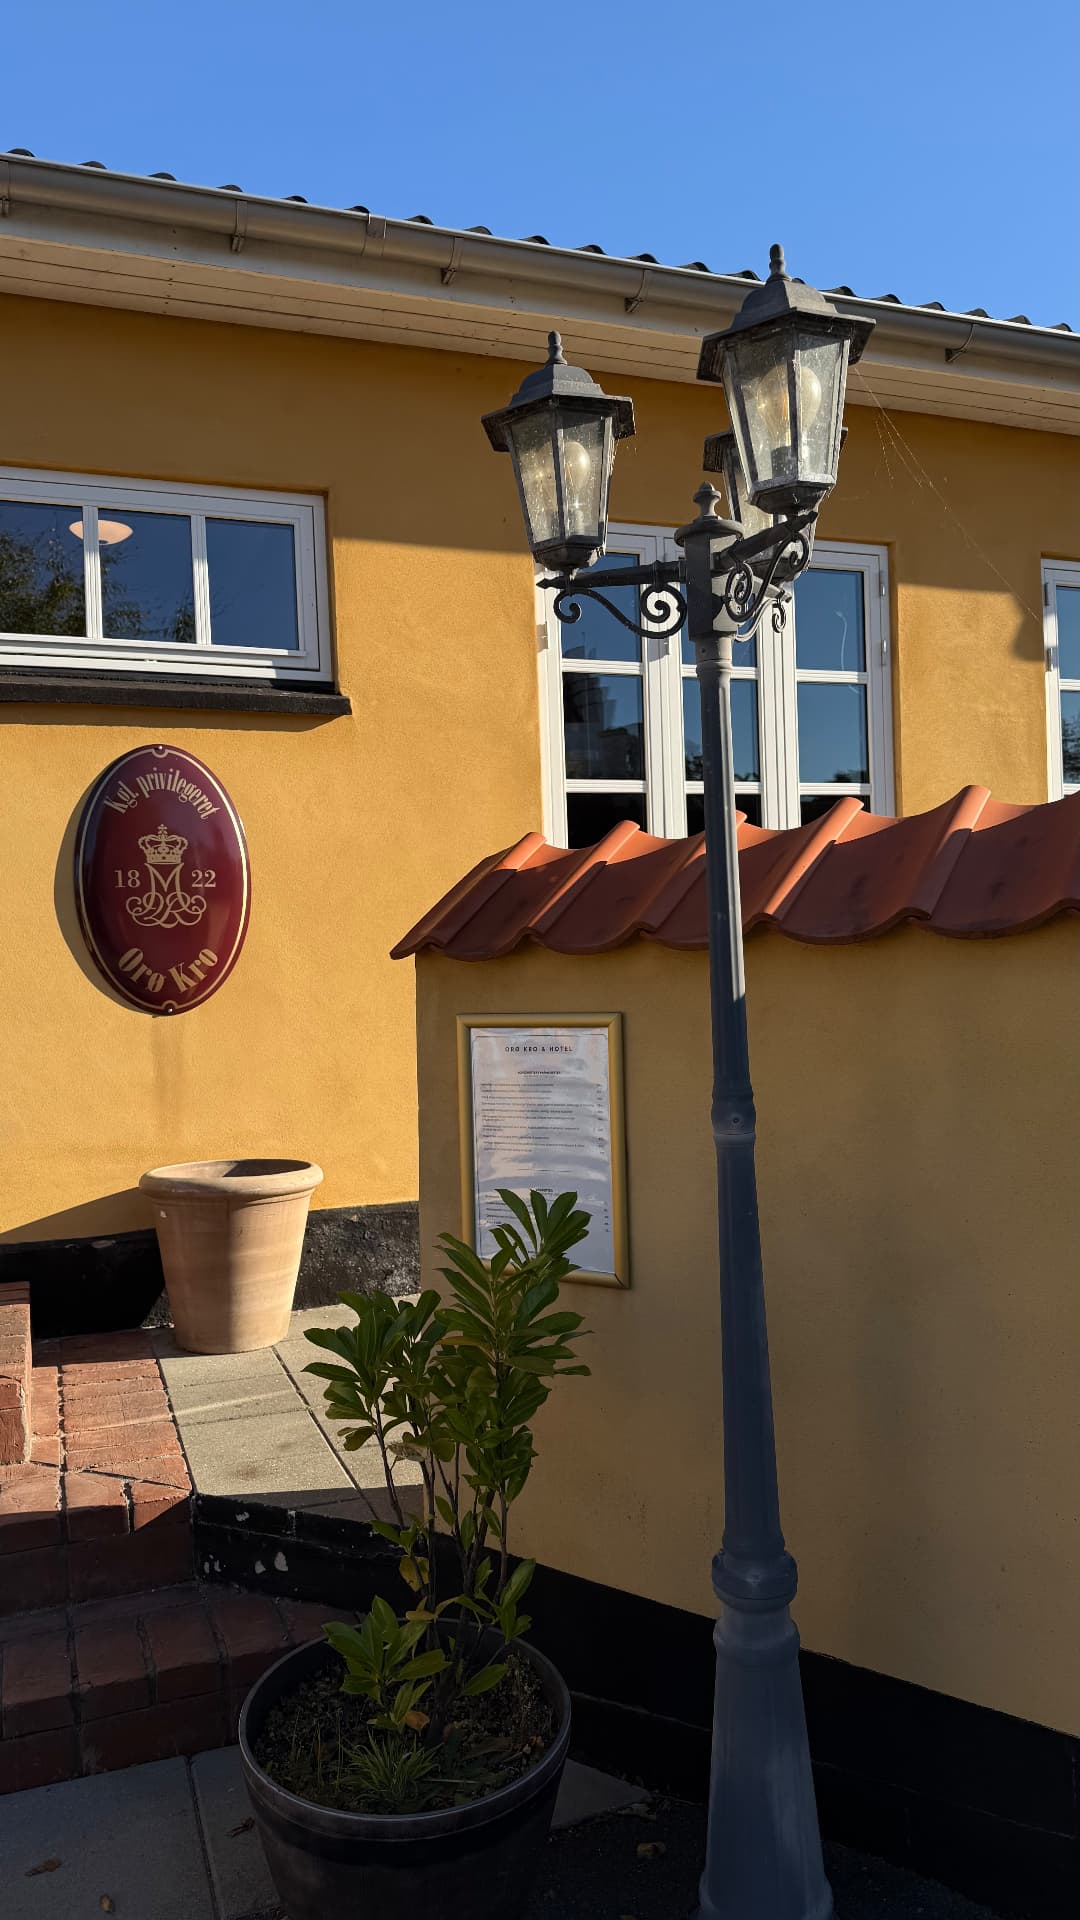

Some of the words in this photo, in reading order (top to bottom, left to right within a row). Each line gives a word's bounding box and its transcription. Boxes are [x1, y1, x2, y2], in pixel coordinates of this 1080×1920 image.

[104, 781, 139, 814] Kgl.
[136, 767, 220, 820] privilegeret
[114, 869, 141, 888] 18
[191, 869, 216, 888] 22
[168, 948, 218, 993] Kro
